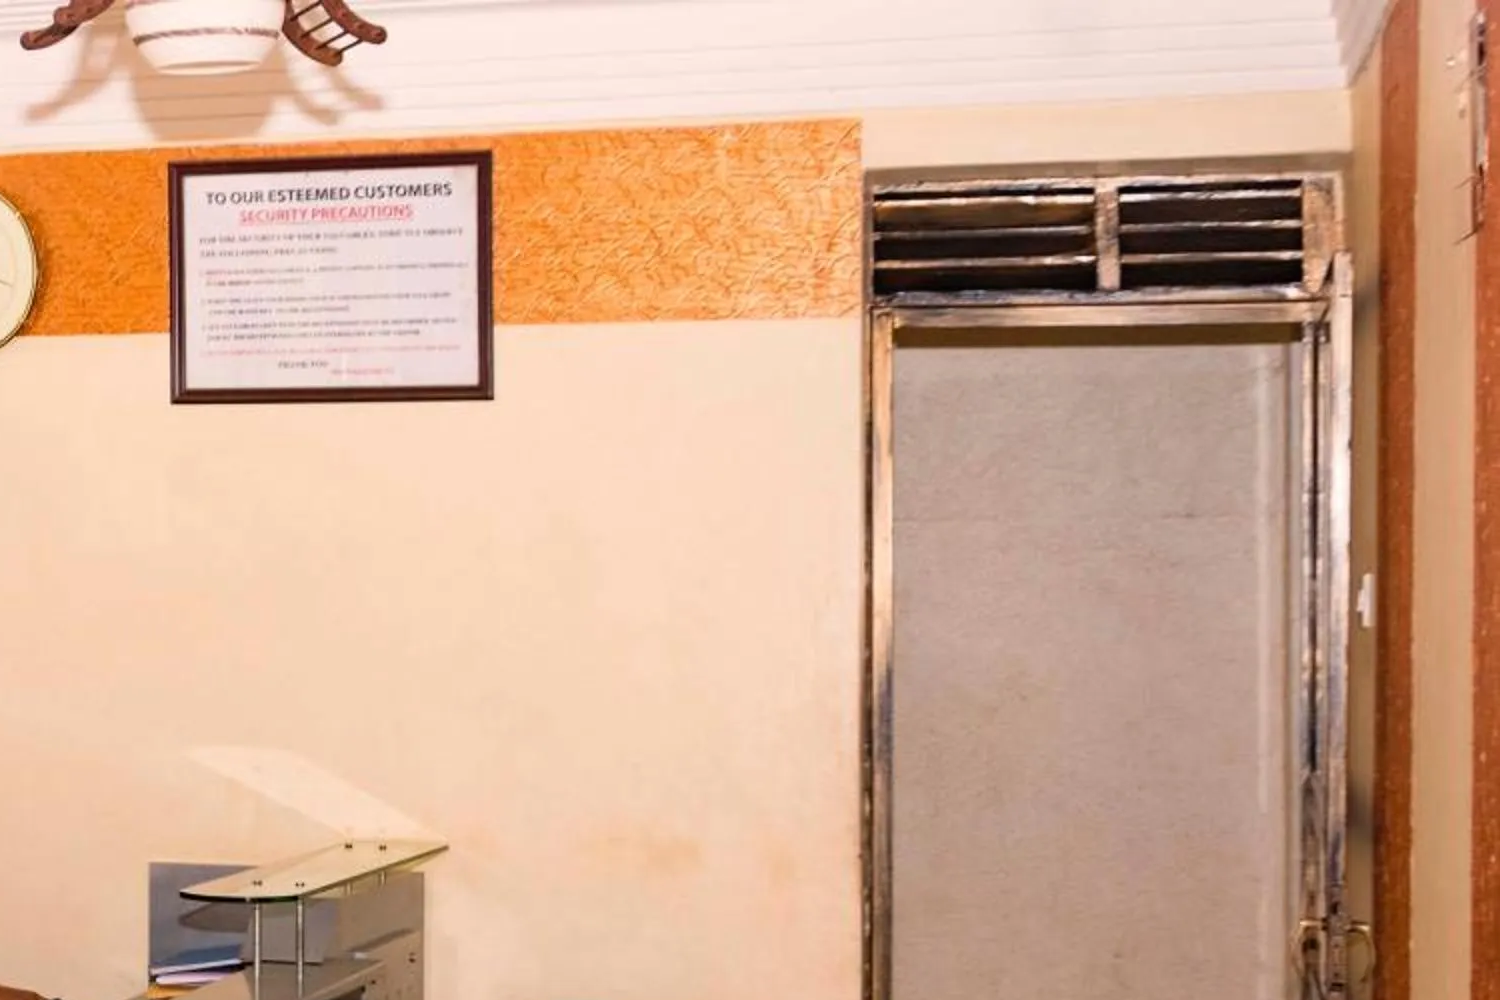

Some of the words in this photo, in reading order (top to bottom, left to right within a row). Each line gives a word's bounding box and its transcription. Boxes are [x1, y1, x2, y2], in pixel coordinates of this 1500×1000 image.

[205, 191, 227, 206] TO
[229, 189, 264, 205] OUR
[267, 186, 350, 203] ESTEEMED
[353, 181, 453, 200] CUSTOMERS
[239, 206, 309, 224] SECURITY
[311, 203, 414, 222] PRECAUTIONS
